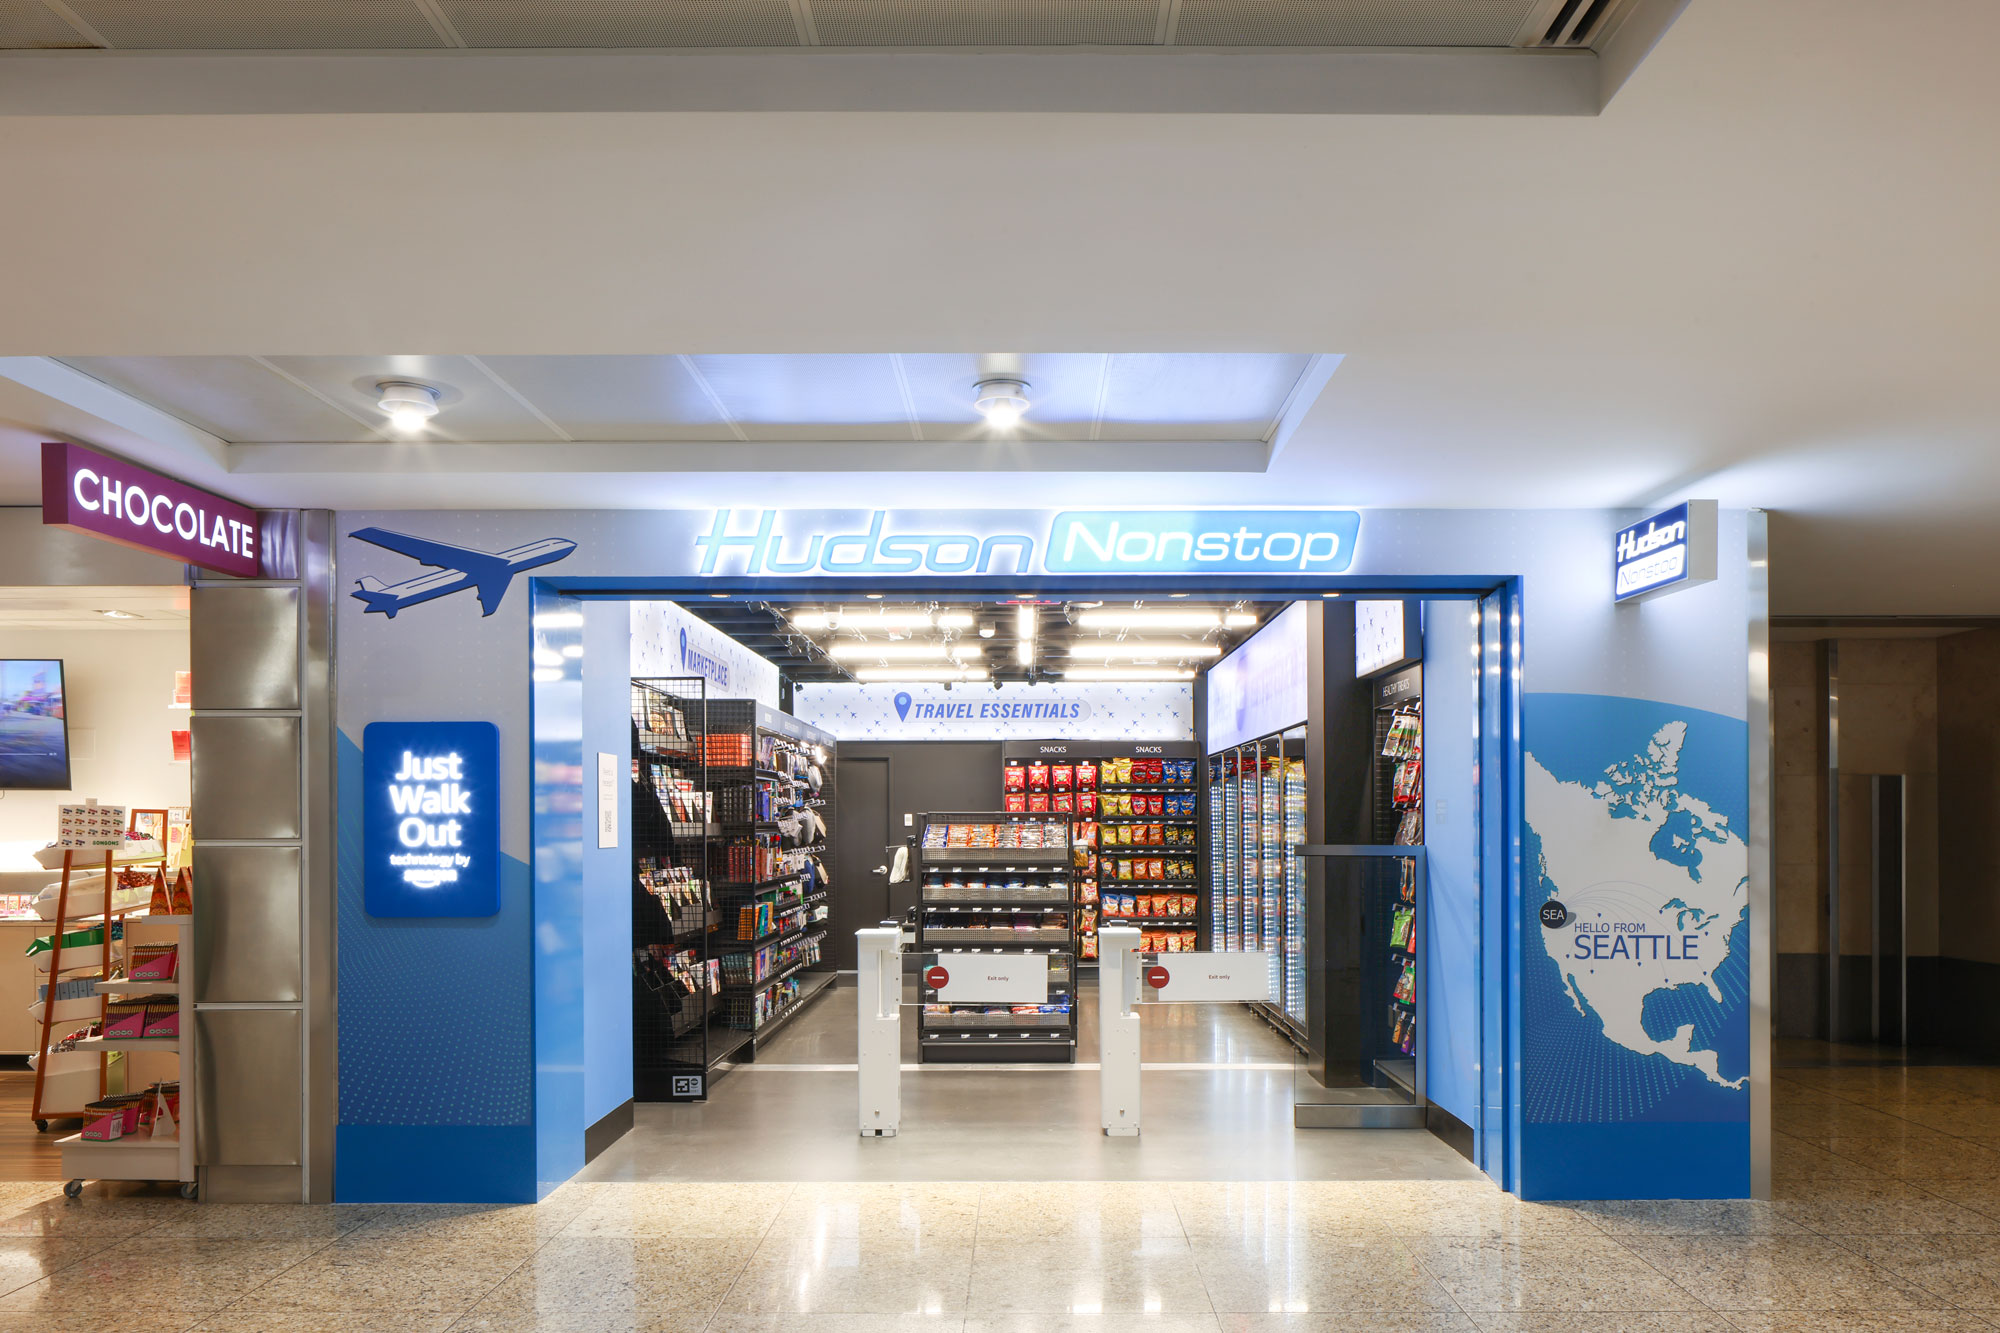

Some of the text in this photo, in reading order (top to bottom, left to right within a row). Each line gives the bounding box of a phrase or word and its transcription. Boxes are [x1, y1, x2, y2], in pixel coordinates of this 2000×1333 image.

[73, 468, 254, 559] CHOCOLATE
[694, 508, 1341, 575] Hudson Nonstop
[1617, 520, 1686, 562] Hudson
[1620, 556, 1678, 588] Nonstop
[687, 649, 728, 687] MARKETPLACE
[1382, 678, 1410, 698] HEALTHY TREATS
[915, 703, 1080, 719] TRAVEL ESSENTIALS
[1039, 745, 1067, 754] SNACKS
[1135, 745, 1162, 754] SNACKS
[395, 751, 463, 781] Just
[388, 783, 472, 815] Walk
[399, 817, 463, 848] Out
[390, 853, 471, 868] technology by
[1542, 909, 1565, 920] SEA
[1574, 922, 1646, 933] HELLO FROM
[1574, 934, 1699, 960] SEATTLE
